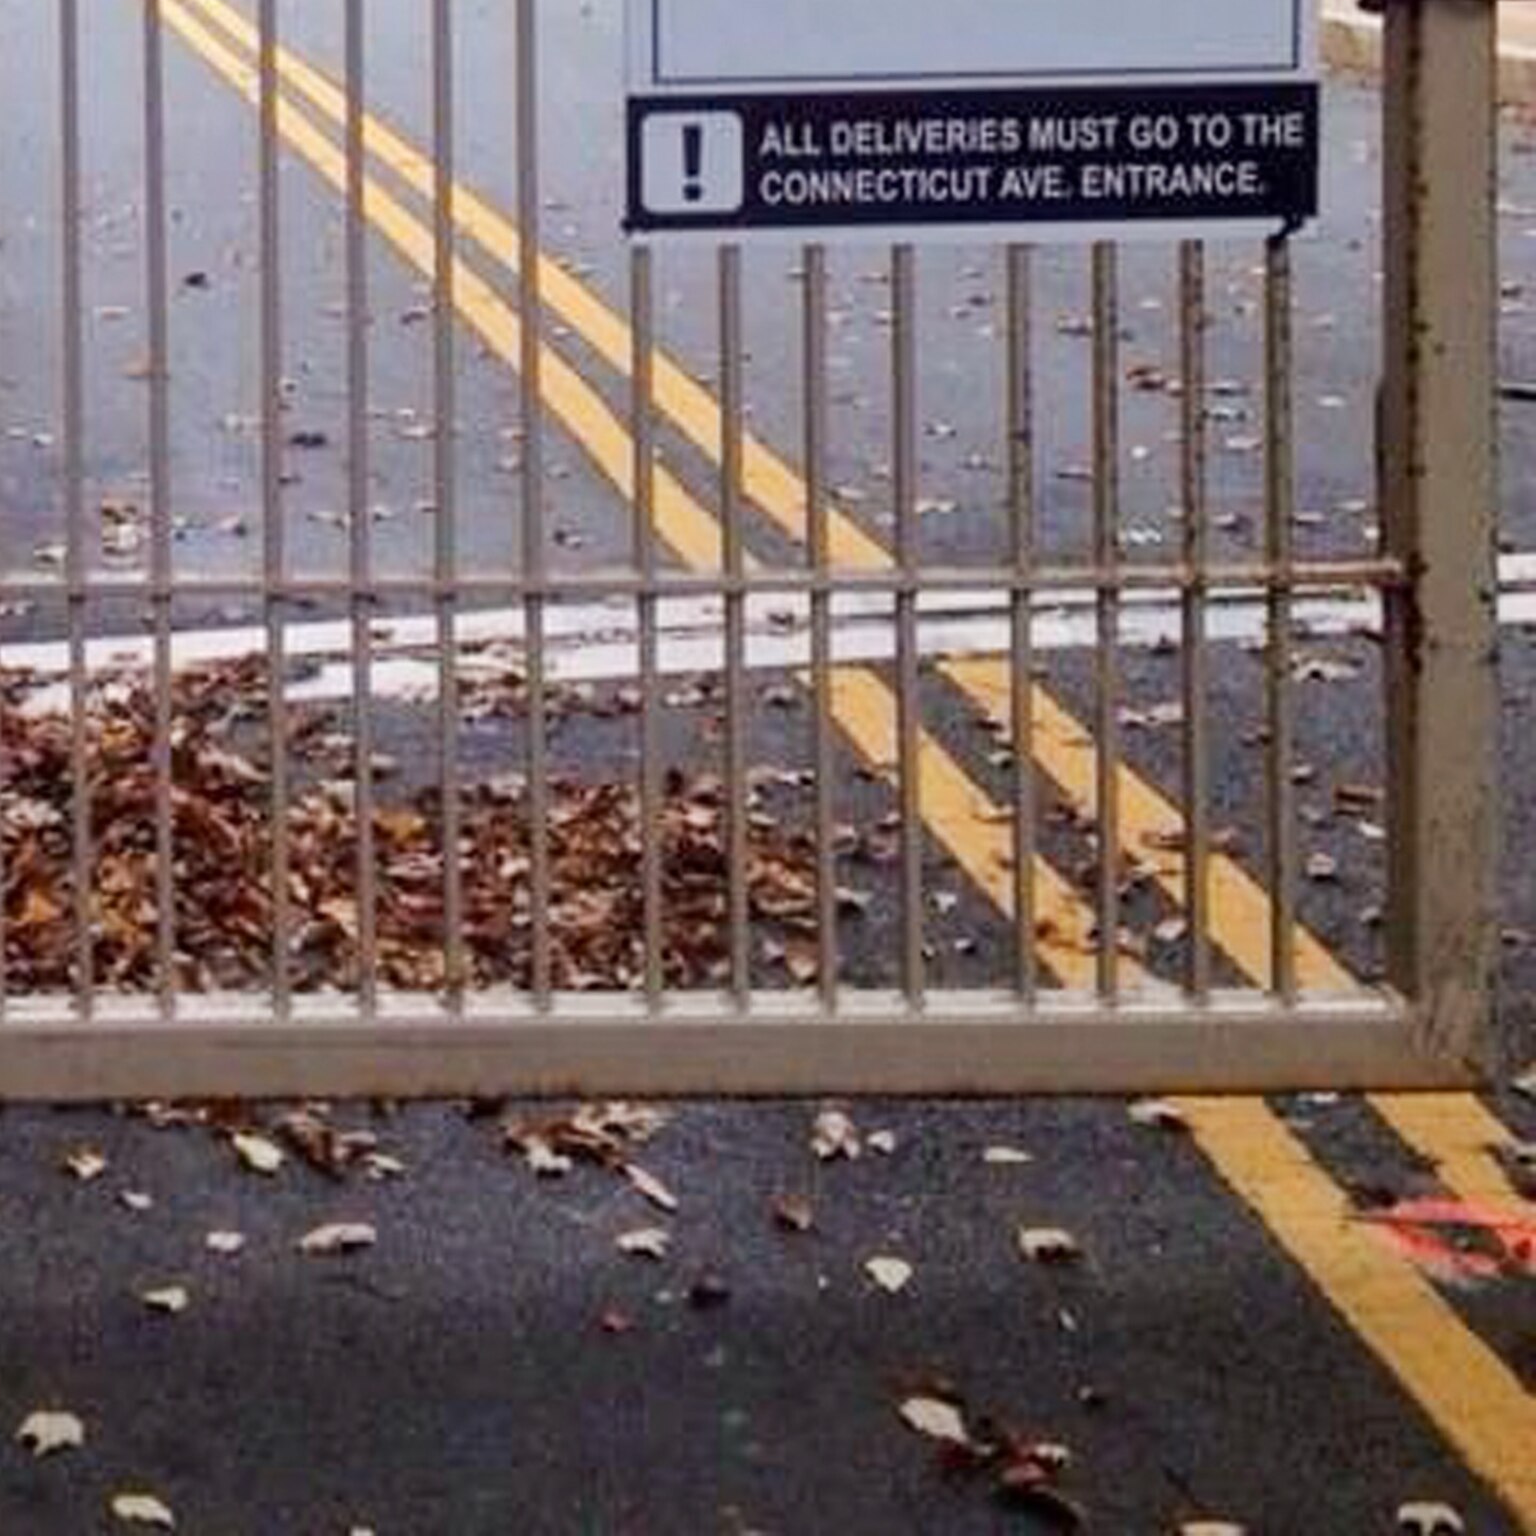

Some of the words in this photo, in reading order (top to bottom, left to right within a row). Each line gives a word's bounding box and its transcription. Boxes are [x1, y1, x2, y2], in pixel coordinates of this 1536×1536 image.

[760, 124, 821, 156] ALL
[831, 118, 1020, 155] DELIVERIES
[1029, 116, 1118, 150] MUST
[1129, 116, 1179, 149] GO
[1187, 114, 1232, 147] TO
[1243, 112, 1304, 146] THE
[760, 167, 991, 205] CONNECTICUT
